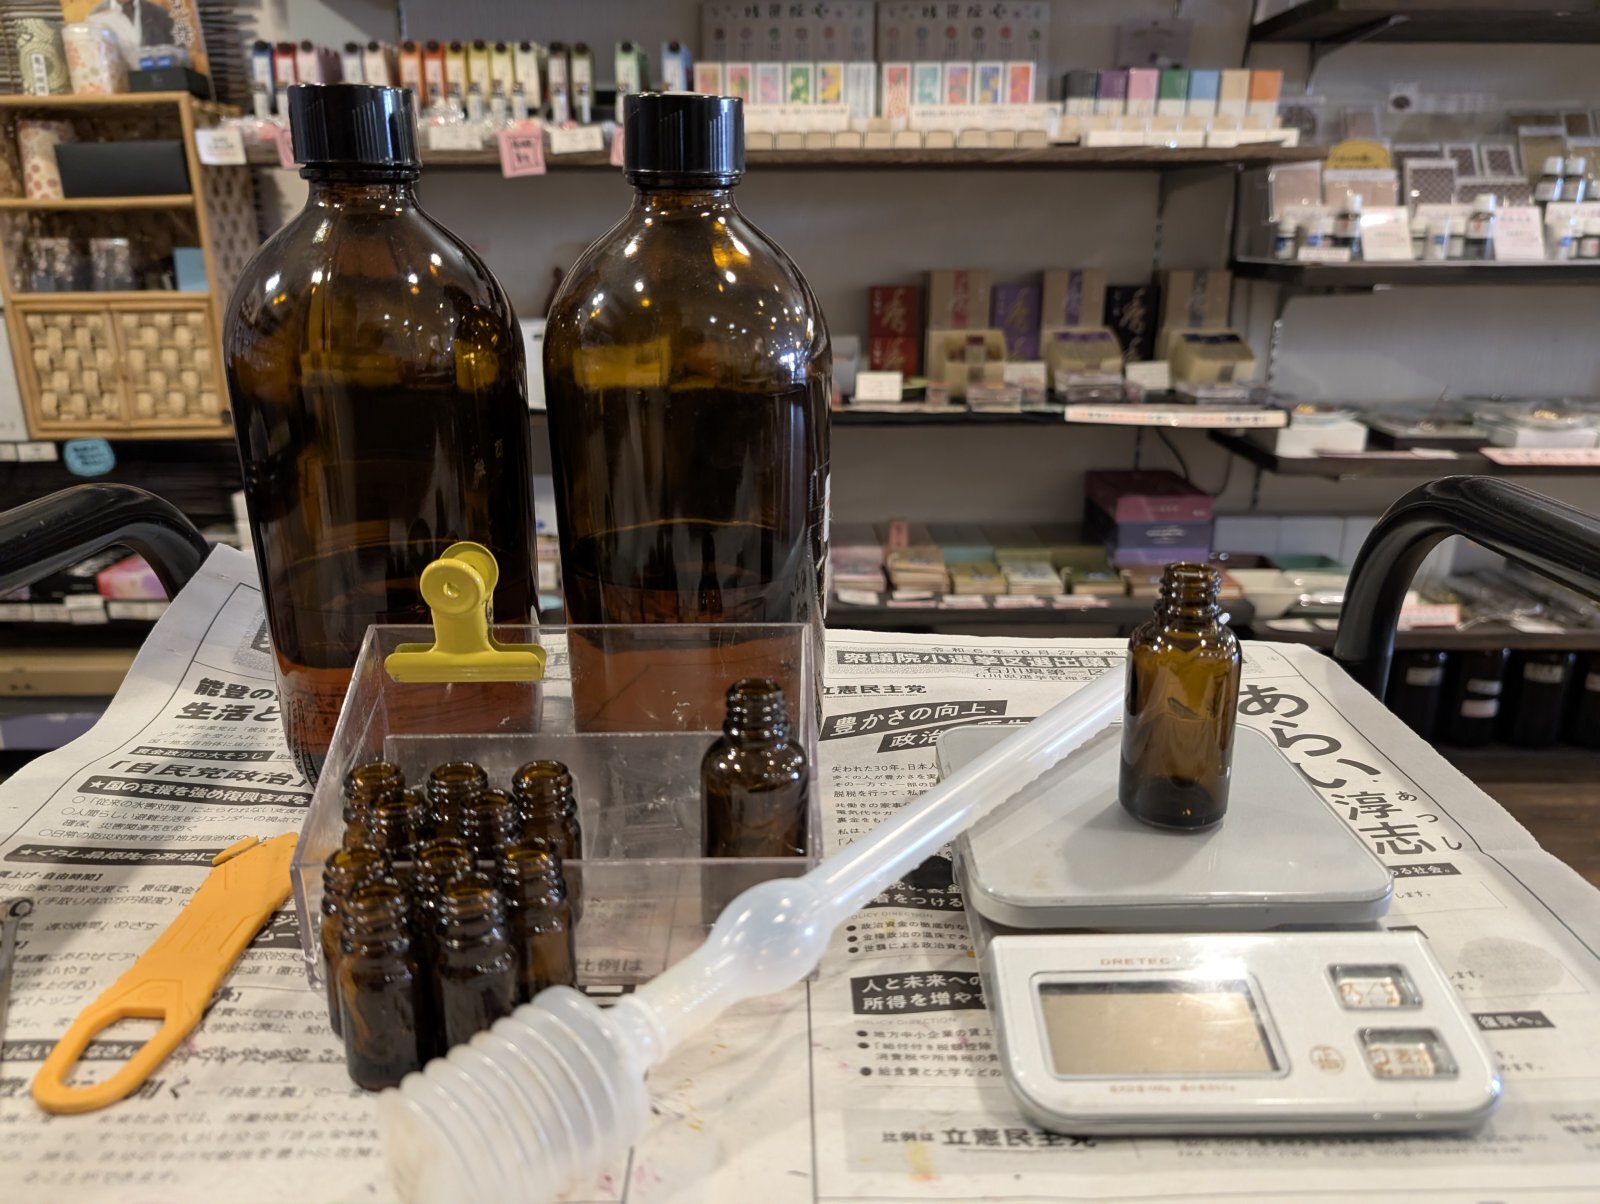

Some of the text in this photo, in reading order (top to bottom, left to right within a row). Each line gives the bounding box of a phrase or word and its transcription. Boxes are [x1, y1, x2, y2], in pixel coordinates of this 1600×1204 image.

[931, 646, 1128, 657] 令和6年10月27日執
[194, 677, 279, 702] 能登の
[829, 702, 1000, 737] 豊かさの向上、
[108, 759, 306, 787] 「自民党政治」
[861, 920, 969, 931] 政治資金の徹底的な
